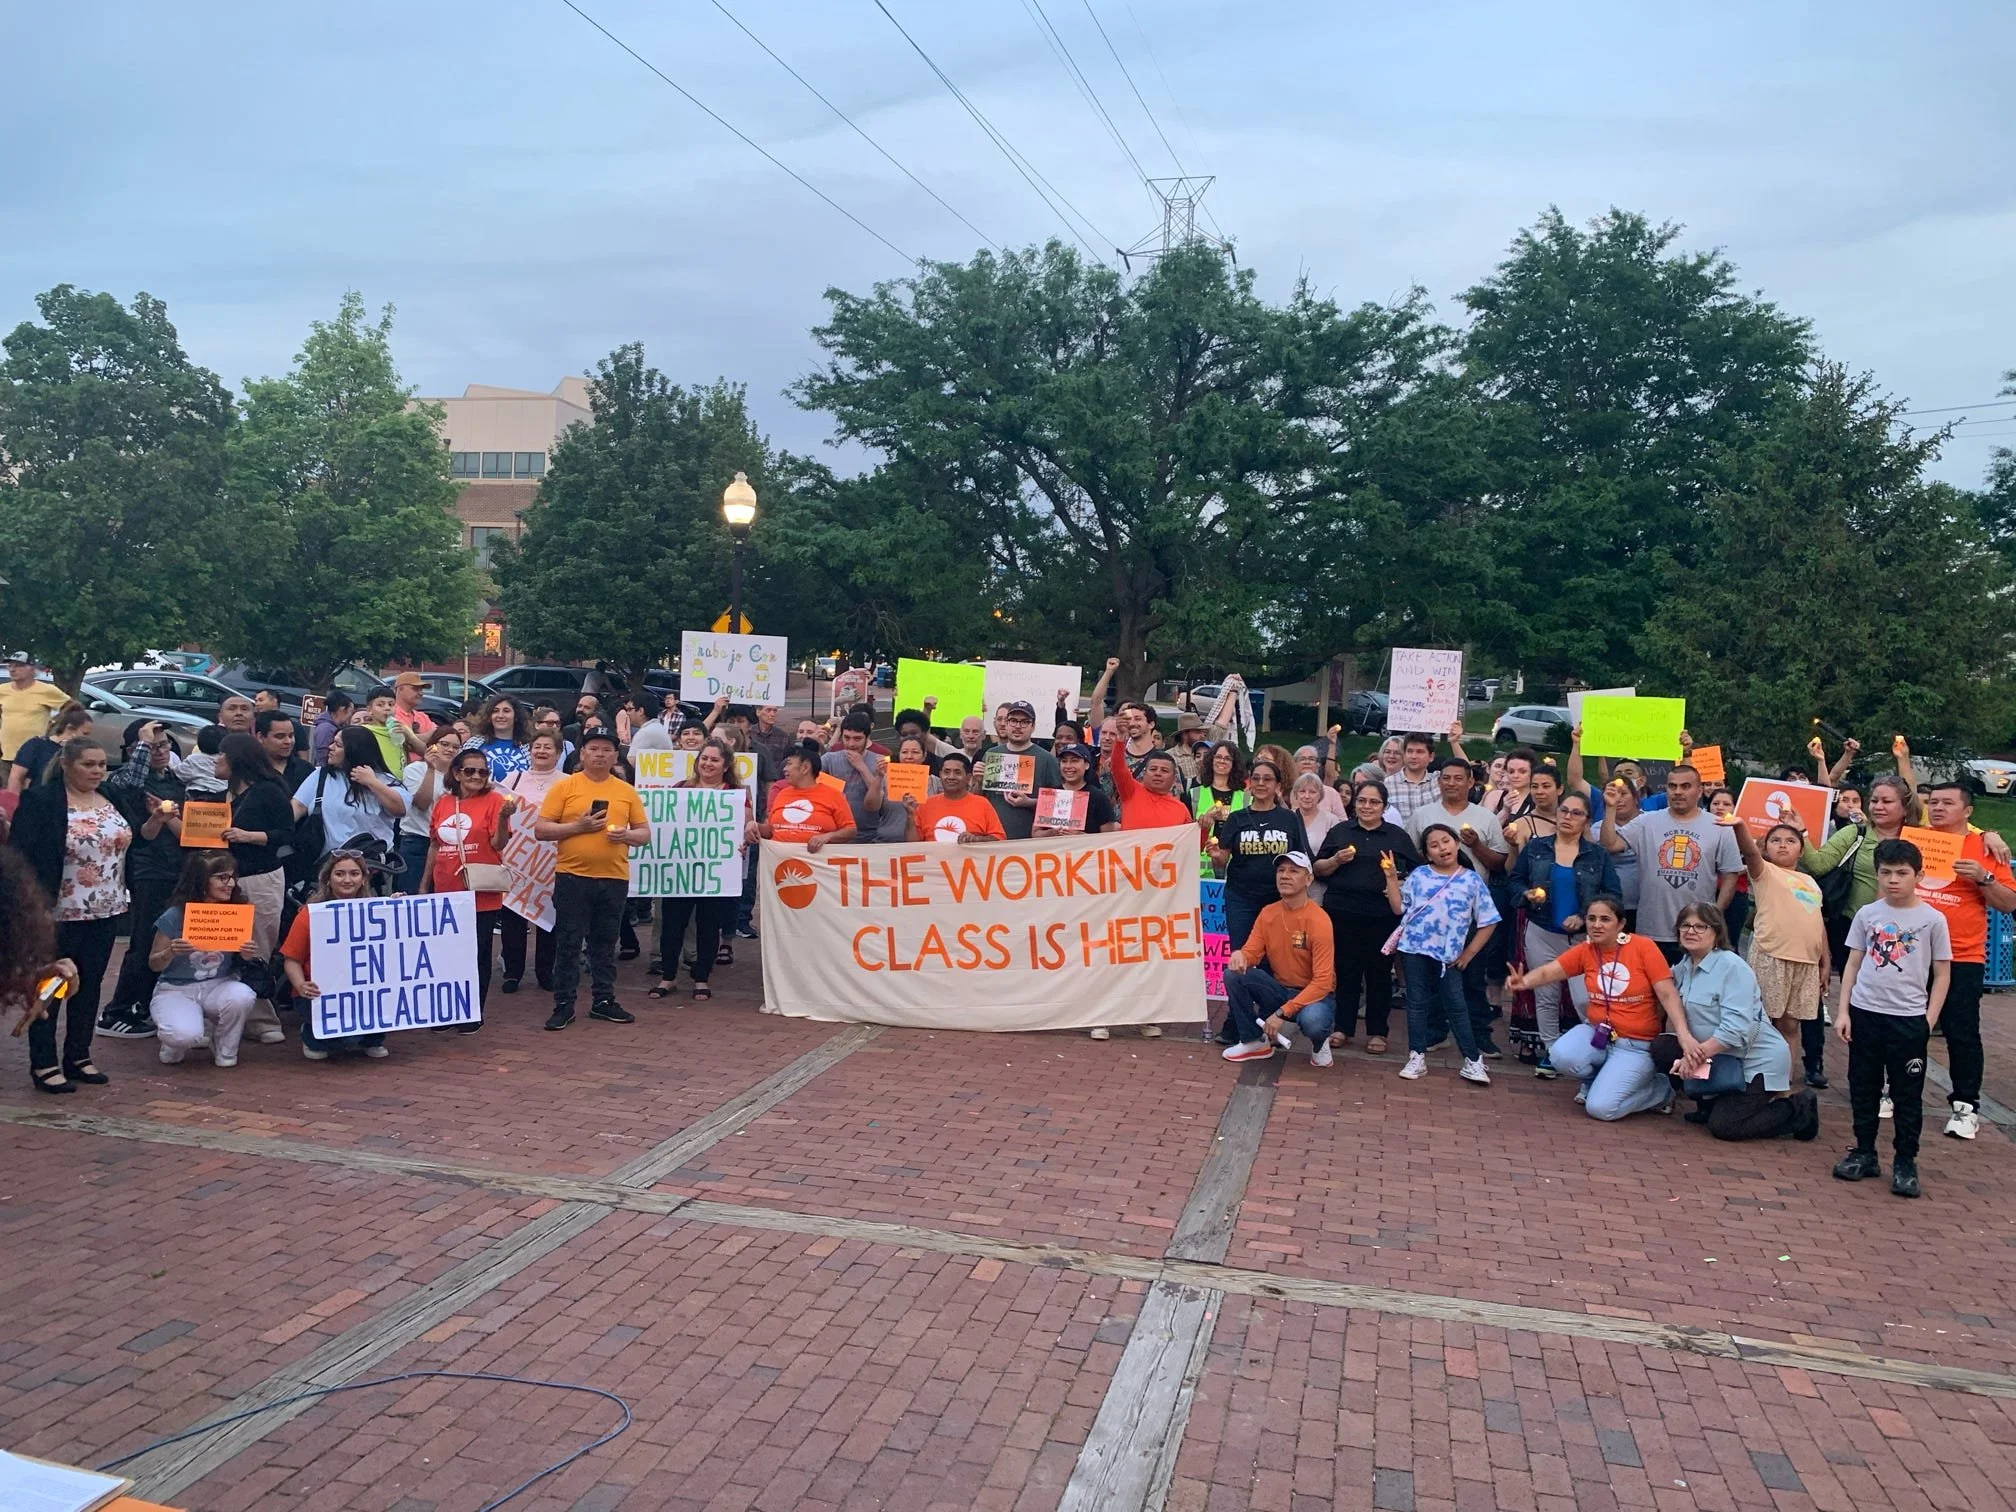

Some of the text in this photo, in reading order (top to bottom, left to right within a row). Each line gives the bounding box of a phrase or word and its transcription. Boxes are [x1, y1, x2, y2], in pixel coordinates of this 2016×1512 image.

[749, 644, 777, 662] Con
[1396, 665, 1457, 677] AND WIN
[707, 677, 771, 700] Dignidad
[640, 753, 674, 778] WE
[686, 790, 736, 823] MAS
[1240, 830, 1288, 842] WE ARE
[1240, 842, 1288, 855] FREEDOM
[637, 861, 722, 896] DIGNOS
[827, 843, 1177, 908] THE WORKING
[325, 897, 460, 944] JUSTICIA
[852, 907, 1202, 972] CLASS IS HERE!
[350, 941, 435, 986] EN LA
[320, 980, 472, 1036] EDUCACION
